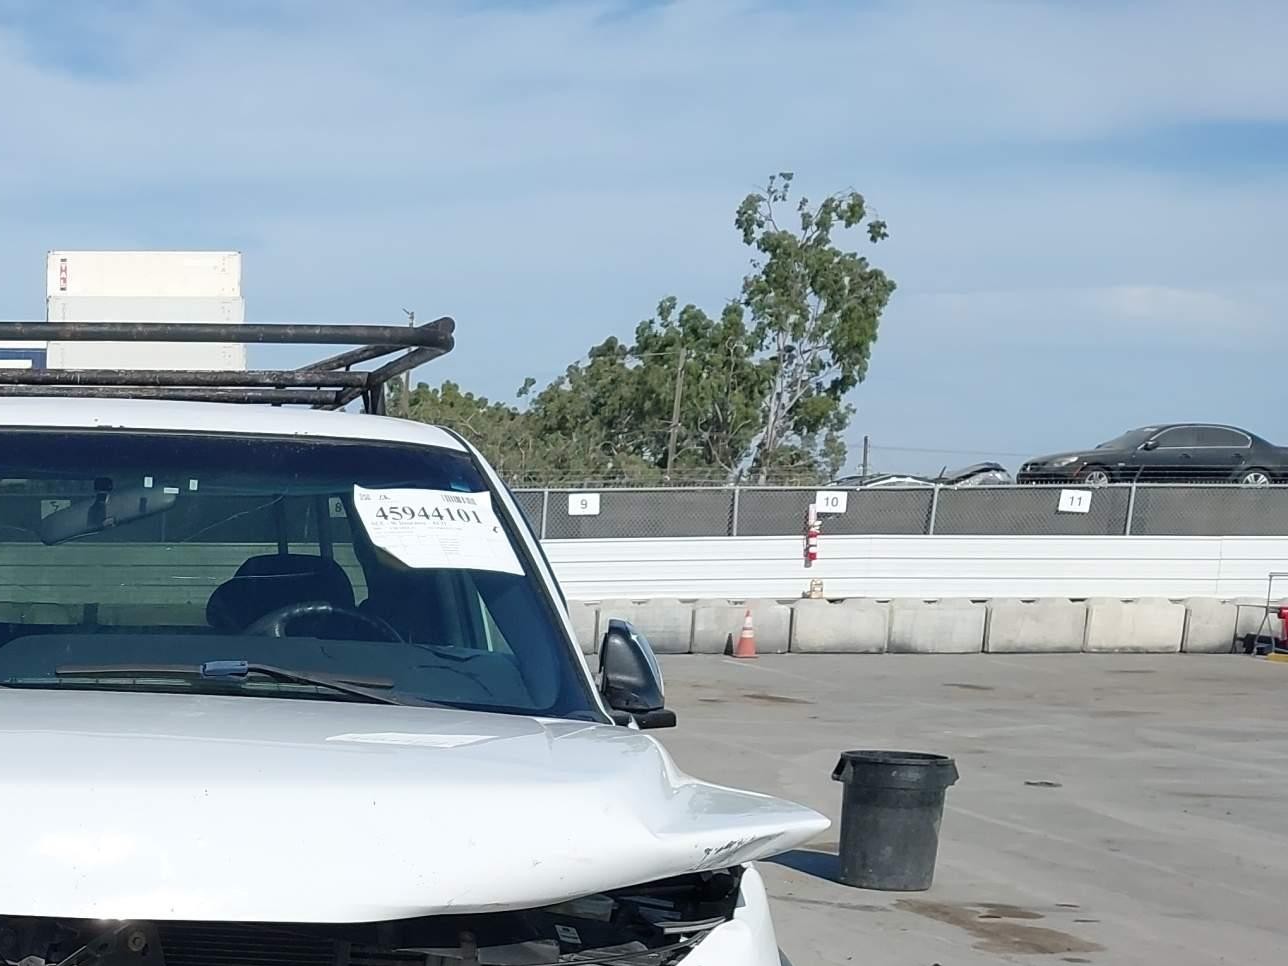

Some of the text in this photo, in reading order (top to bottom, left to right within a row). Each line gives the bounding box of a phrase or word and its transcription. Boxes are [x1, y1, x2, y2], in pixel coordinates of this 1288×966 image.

[580, 499, 588, 509] 9
[824, 496, 839, 507] 10
[1069, 496, 1082, 506] 11
[335, 502, 342, 513] 8
[375, 506, 483, 524] 45944101
